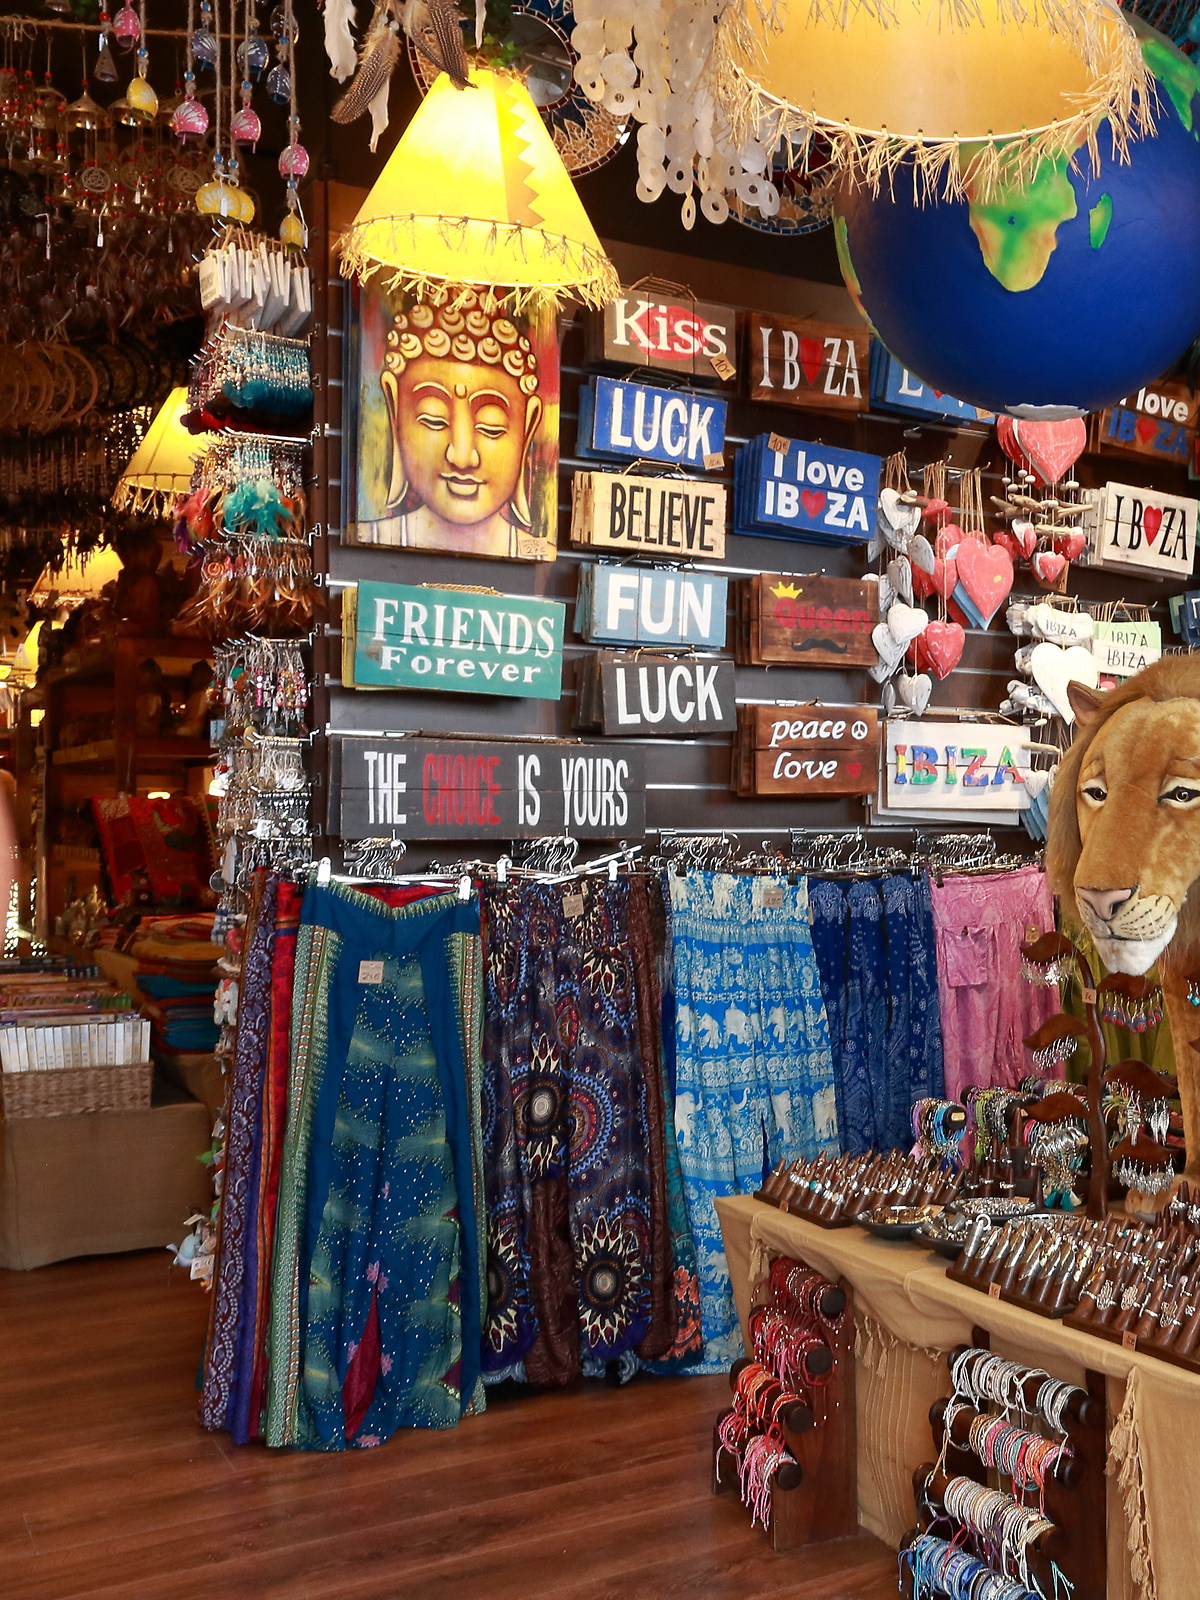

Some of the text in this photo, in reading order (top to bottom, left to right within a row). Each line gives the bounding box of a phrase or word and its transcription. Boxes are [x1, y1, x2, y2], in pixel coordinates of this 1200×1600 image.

[611, 298, 728, 357] Kiss
[610, 387, 715, 460] LUCK
[1136, 387, 1189, 422] love
[796, 451, 865, 491] love
[609, 482, 715, 552] BELIEVE
[606, 572, 713, 639] FUN
[773, 599, 871, 633] Queen
[372, 598, 555, 659] FRIENDS
[1045, 619, 1078, 638] IBIZA
[379, 645, 541, 684] Forever
[1107, 648, 1147, 669] IBIZA
[615, 664, 724, 725] LUCK
[768, 718, 846, 748] peace
[772, 752, 838, 780] love
[894, 744, 1025, 787] IBIZA
[363, 751, 629, 827] THE CHOICE IS YOURS
